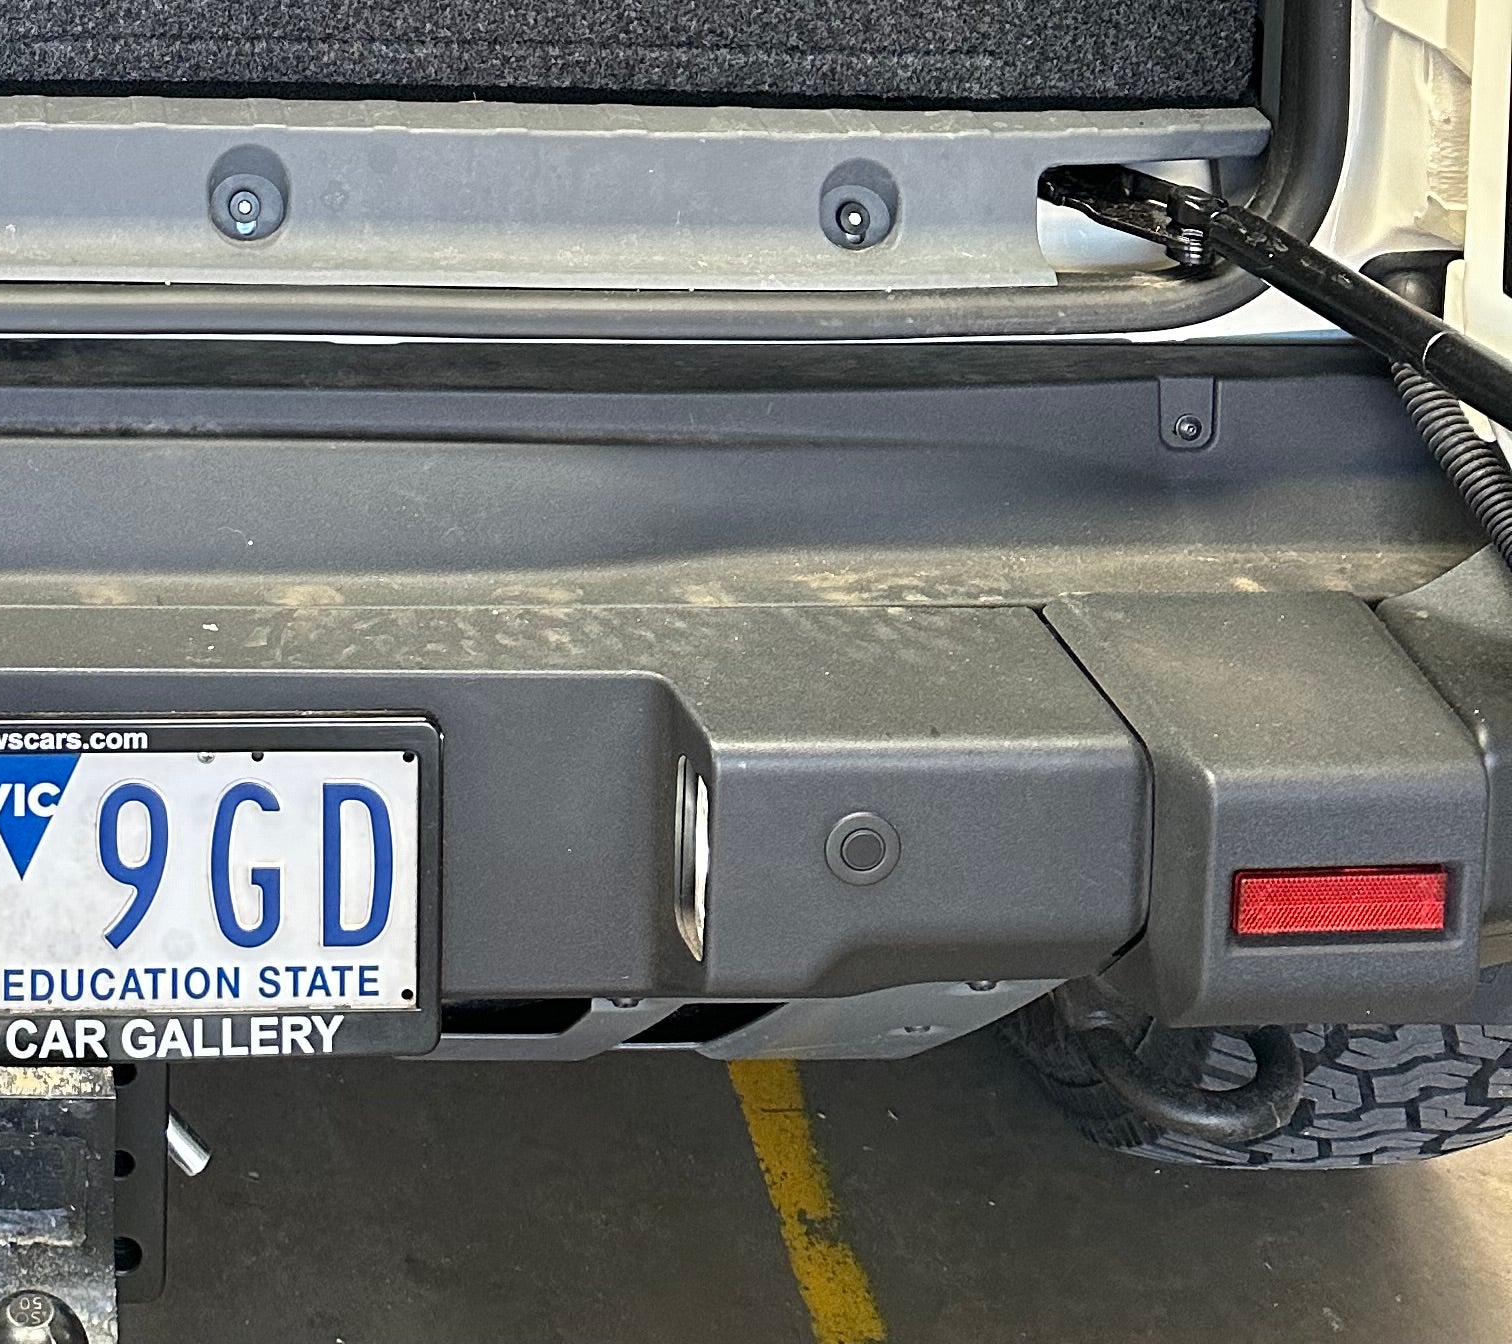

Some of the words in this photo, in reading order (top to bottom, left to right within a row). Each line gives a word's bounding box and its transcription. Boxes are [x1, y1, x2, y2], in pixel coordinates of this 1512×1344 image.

[99, 782, 394, 950] 9GD
[3, 967, 243, 1002] EDUCATION
[258, 965, 380, 998] STATE
[4, 1019, 109, 1060] CAR
[121, 1015, 345, 1059] GALLERY
